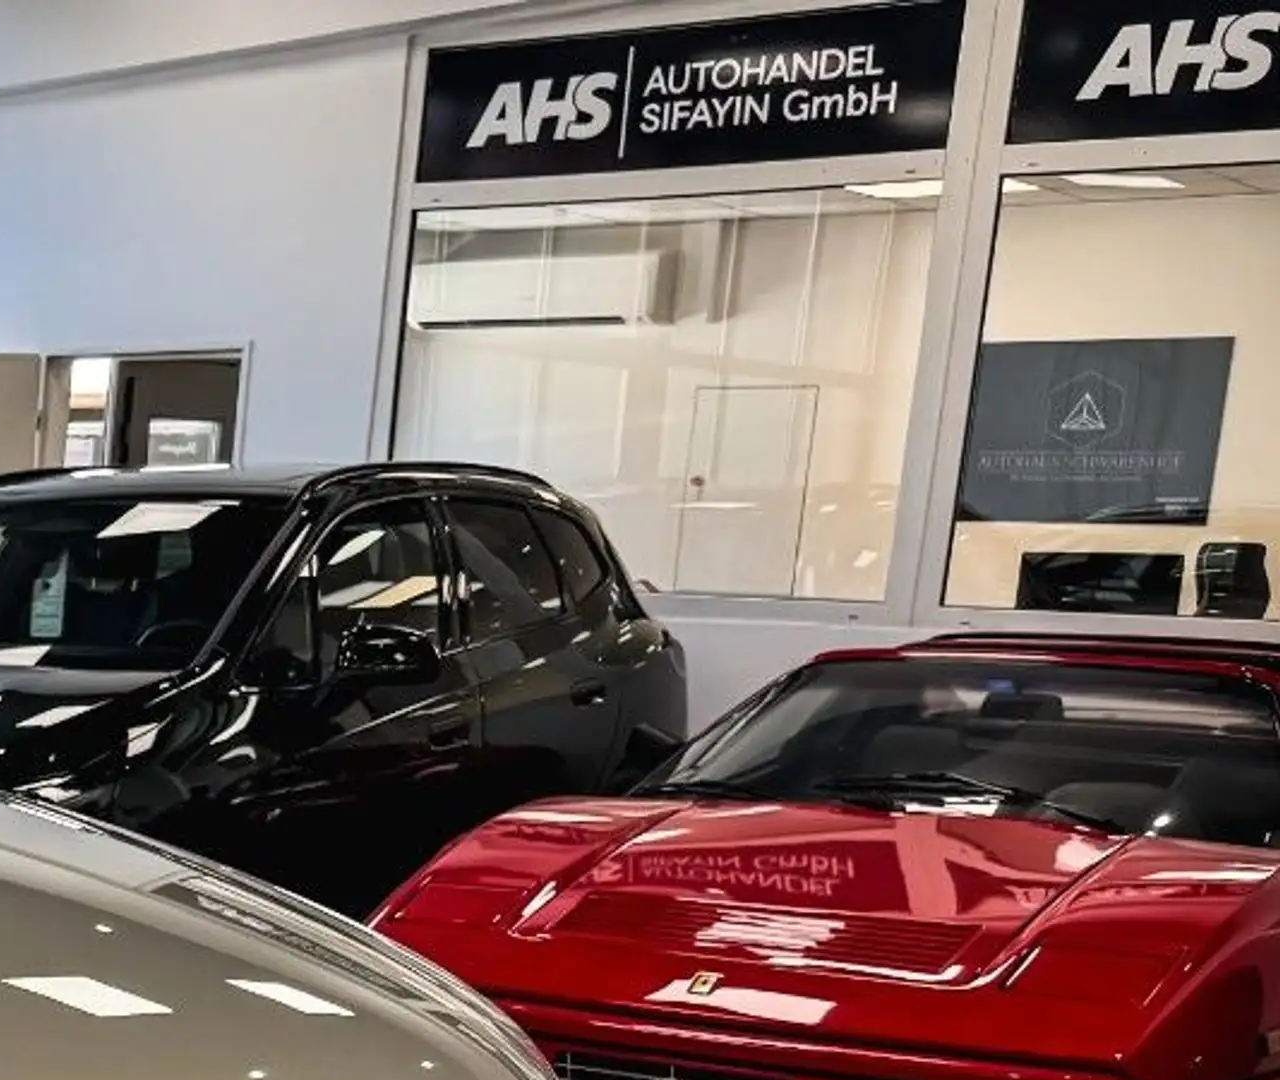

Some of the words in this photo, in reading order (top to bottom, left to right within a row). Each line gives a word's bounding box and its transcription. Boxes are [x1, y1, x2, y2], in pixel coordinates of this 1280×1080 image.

[642, 44, 886, 98] AUTOHANDEL
[1074, 11, 1280, 102] AHS
[465, 72, 619, 149] AHS
[639, 92, 770, 135] SIFAYIN
[783, 80, 899, 121] GmbH
